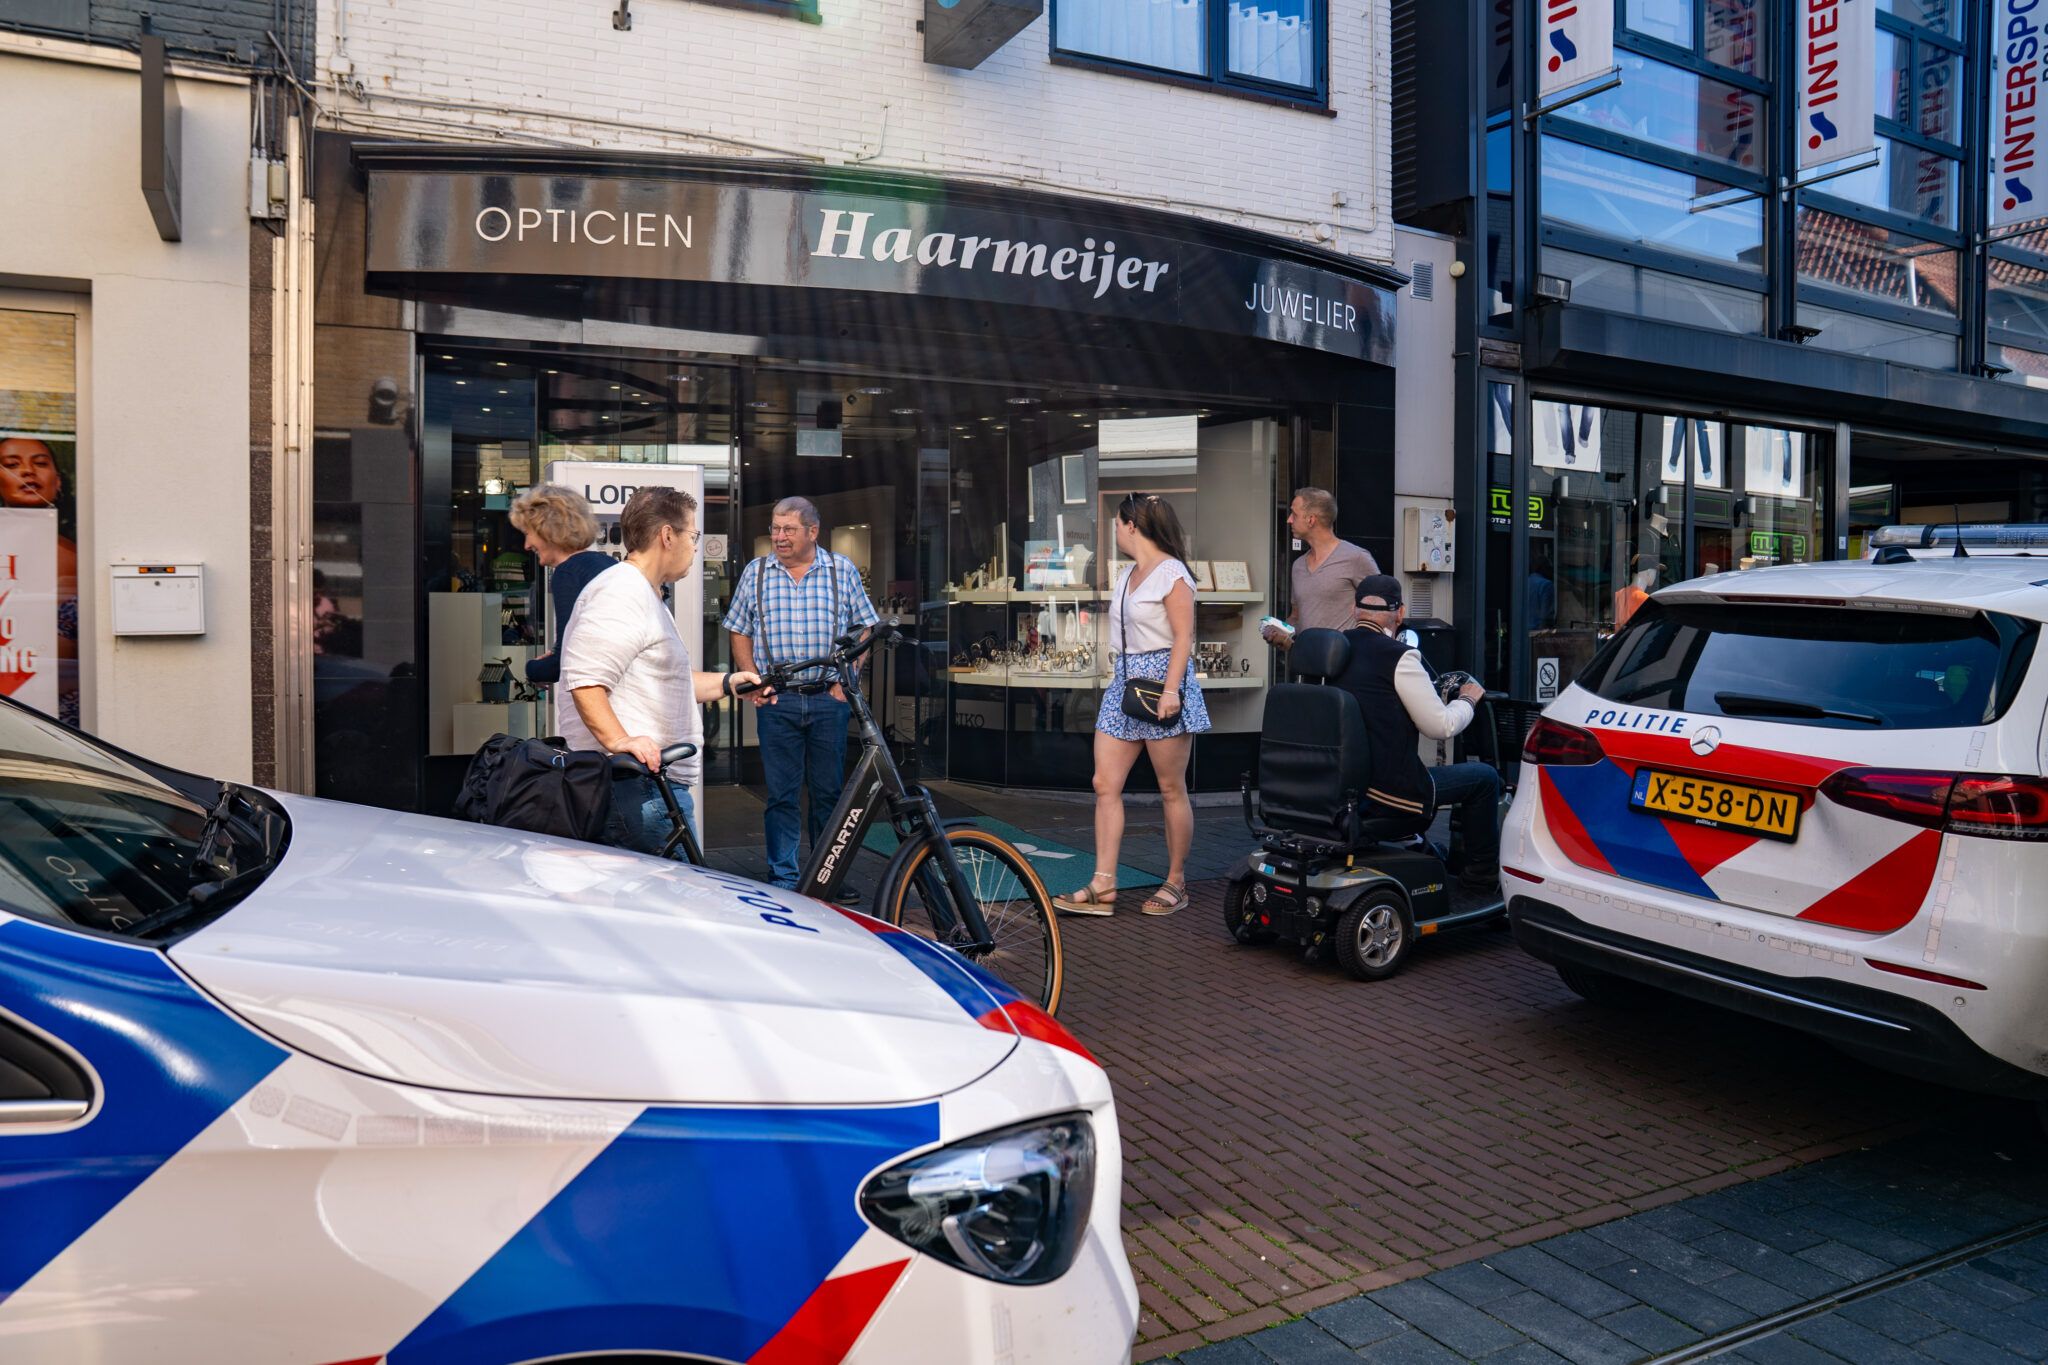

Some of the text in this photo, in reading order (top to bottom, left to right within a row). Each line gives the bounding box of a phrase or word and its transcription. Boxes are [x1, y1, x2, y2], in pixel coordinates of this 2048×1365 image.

[475, 206, 693, 249] OPTICIEN
[810, 208, 1170, 299] Haarmeijer
[1245, 282, 1357, 333] JUWELIER
[1585, 709, 1688, 734] POLITIE
[1634, 790, 1645, 801] NL
[1651, 777, 1788, 828] X-558-DN
[816, 808, 863, 884] SPARTA
